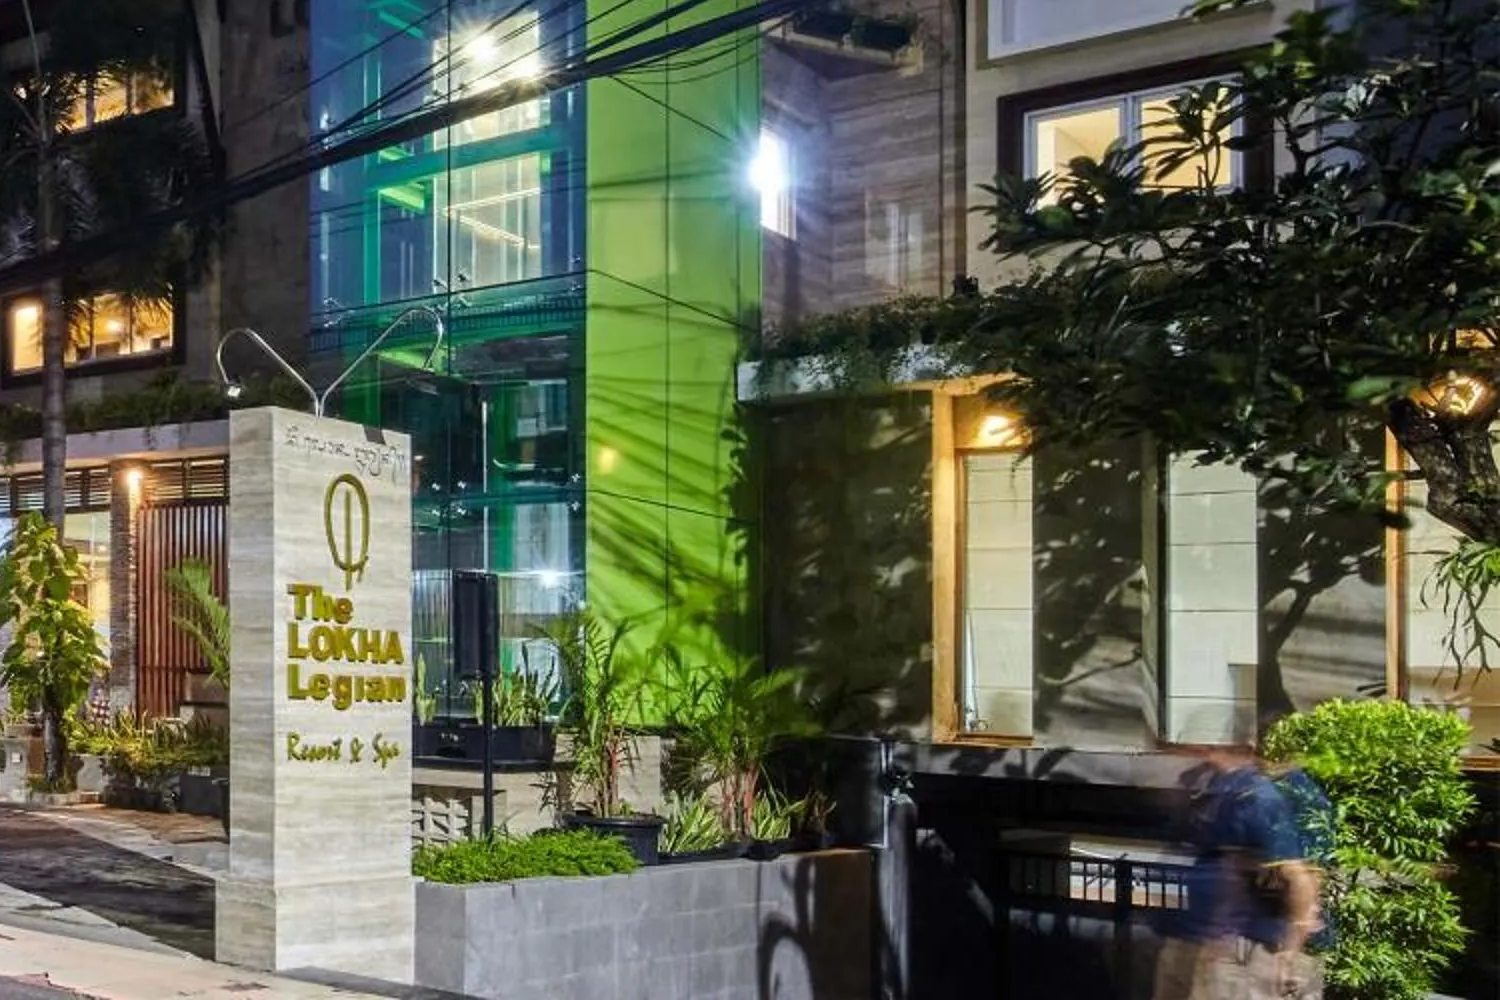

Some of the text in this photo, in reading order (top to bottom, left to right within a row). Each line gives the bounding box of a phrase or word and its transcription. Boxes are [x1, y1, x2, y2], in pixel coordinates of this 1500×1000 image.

[287, 584, 353, 624] The
[288, 623, 404, 664] LOKHA
[288, 664, 406, 710] Legian
[287, 731, 400, 770] Resort & Spa
